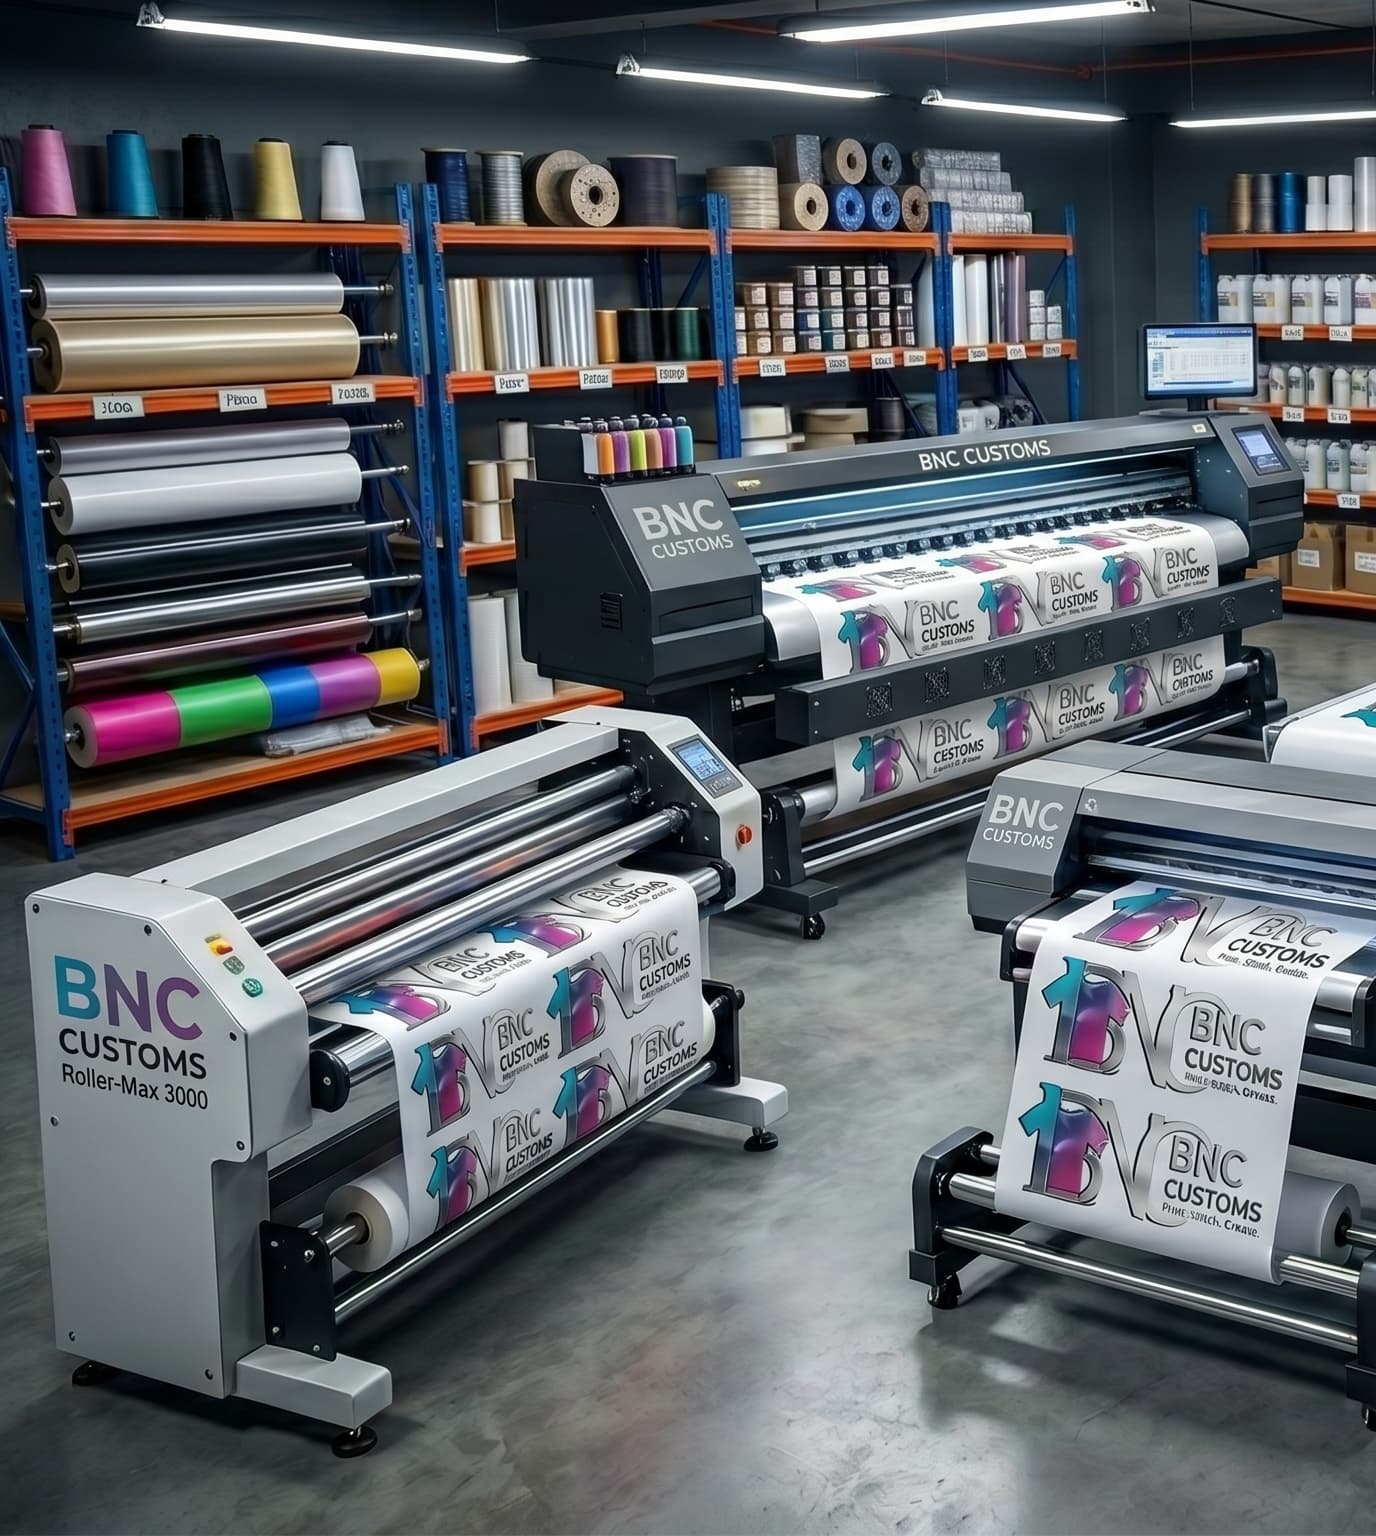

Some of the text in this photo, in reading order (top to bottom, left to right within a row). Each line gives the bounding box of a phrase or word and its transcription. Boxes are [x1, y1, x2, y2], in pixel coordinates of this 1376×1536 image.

[918, 440, 1051, 471] BNC CUSTOMS
[632, 500, 723, 540] BNC
[652, 534, 734, 559] CUSTOMS
[1166, 547, 1198, 569] BNC
[1051, 571, 1085, 595] BNC
[920, 600, 960, 625] BNC
[1052, 590, 1098, 612] CUSTOMS
[1173, 653, 1203, 677] BNC
[1059, 683, 1095, 709] BNC
[1058, 702, 1105, 726] CUSTOMS
[934, 718, 973, 747] BNC
[988, 794, 1064, 833] BNC
[983, 827, 1054, 850] CUSTOMS
[1249, 917, 1338, 947] BNC
[1228, 938, 1330, 968] CUSTOMS
[639, 953, 691, 991] CUSTOMS
[54, 954, 203, 1041] BNC
[1189, 1006, 1267, 1056] BNC
[59, 1028, 208, 1080] CUSTOMS
[499, 1033, 550, 1072] CUSTOMS
[643, 1041, 698, 1085] CUSTOMS
[1184, 1047, 1283, 1091] CUSTOMS
[61, 1063, 208, 1110] Roller-Max 3000
[1169, 1135, 1248, 1189] BNC
[1164, 1178, 1263, 1223] CUSTOMS
